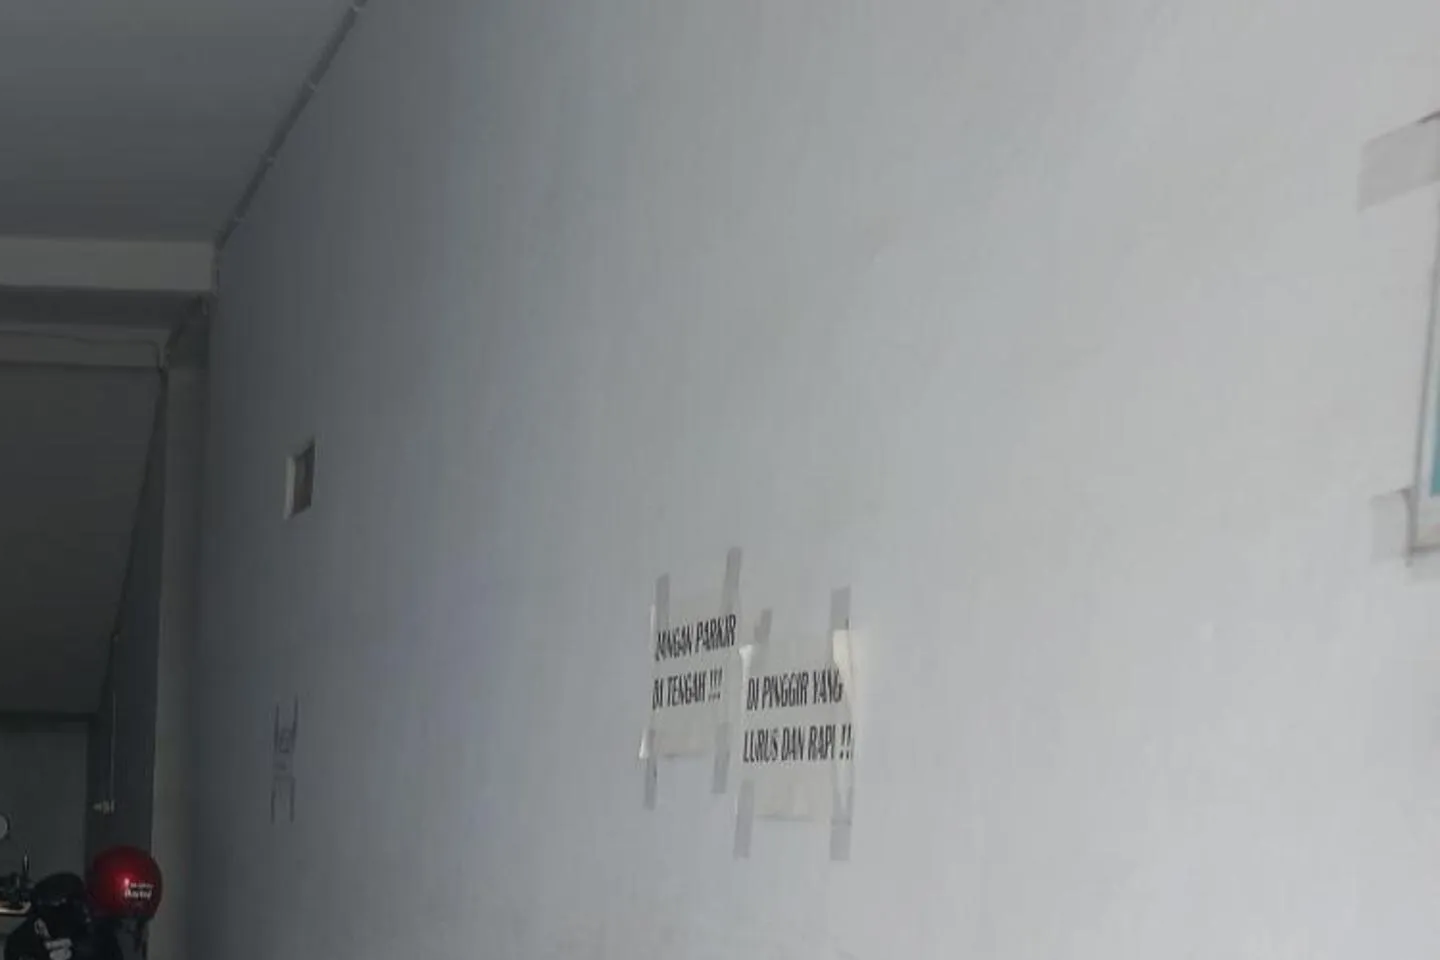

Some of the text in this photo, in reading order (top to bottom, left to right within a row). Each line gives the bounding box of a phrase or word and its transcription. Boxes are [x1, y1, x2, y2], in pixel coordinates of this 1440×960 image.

[695, 613, 737, 653] PARKIR
[652, 678, 663, 710] DI
[667, 669, 707, 707] TENGAH
[747, 667, 844, 711] DI PINGGIR YANG
[808, 724, 836, 761] RAPI
